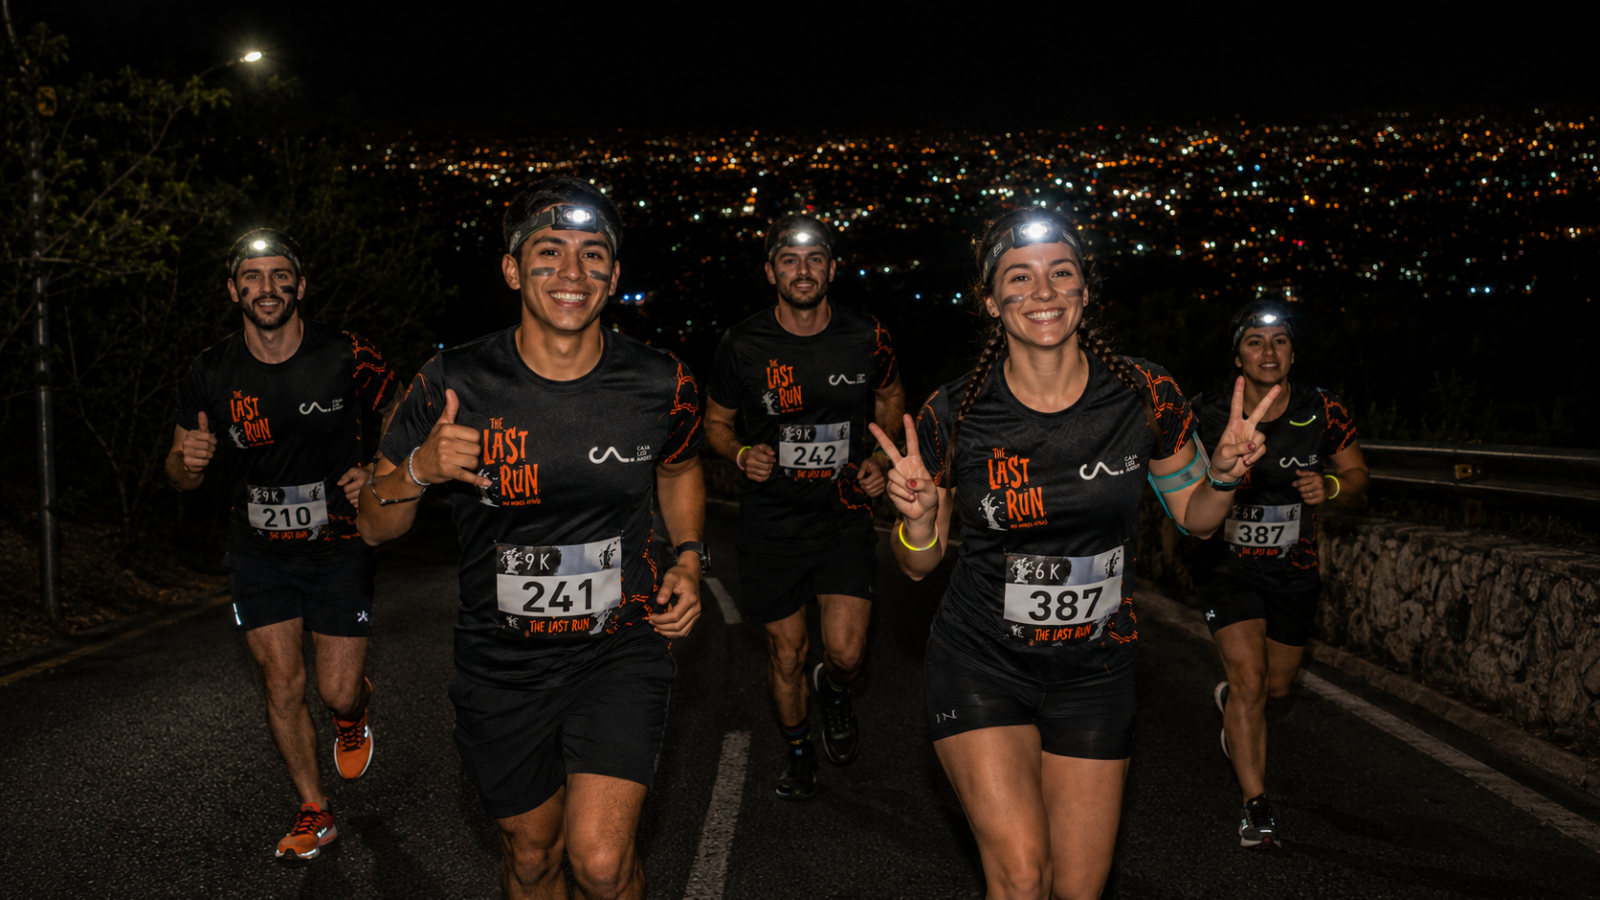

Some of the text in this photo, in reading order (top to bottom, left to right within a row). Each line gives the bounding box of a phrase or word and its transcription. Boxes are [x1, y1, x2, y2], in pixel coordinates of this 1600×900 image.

[766, 364, 793, 389] LAST
[779, 385, 802, 408] RUN
[230, 396, 259, 422] LAST
[243, 418, 271, 442] RUN
[490, 417, 504, 430] THE
[796, 428, 811, 440] 9 K
[483, 427, 528, 465] LAST
[793, 445, 836, 466] 242
[992, 447, 1008, 459] THE
[500, 463, 539, 499] RUN
[987, 455, 1030, 490] LAST
[262, 490, 279, 502] 9 K
[1005, 486, 1044, 522] RUN
[262, 506, 311, 527] 210
[1251, 508, 1258, 519] K
[1238, 524, 1285, 544] 387
[525, 553, 550, 570] 9 K
[1036, 562, 1060, 580] 6 K
[522, 578, 592, 613] 241
[1029, 586, 1103, 621] 387
[530, 617, 590, 633] THE LAST RUN
[1035, 623, 1092, 641] THE LAST RUN
